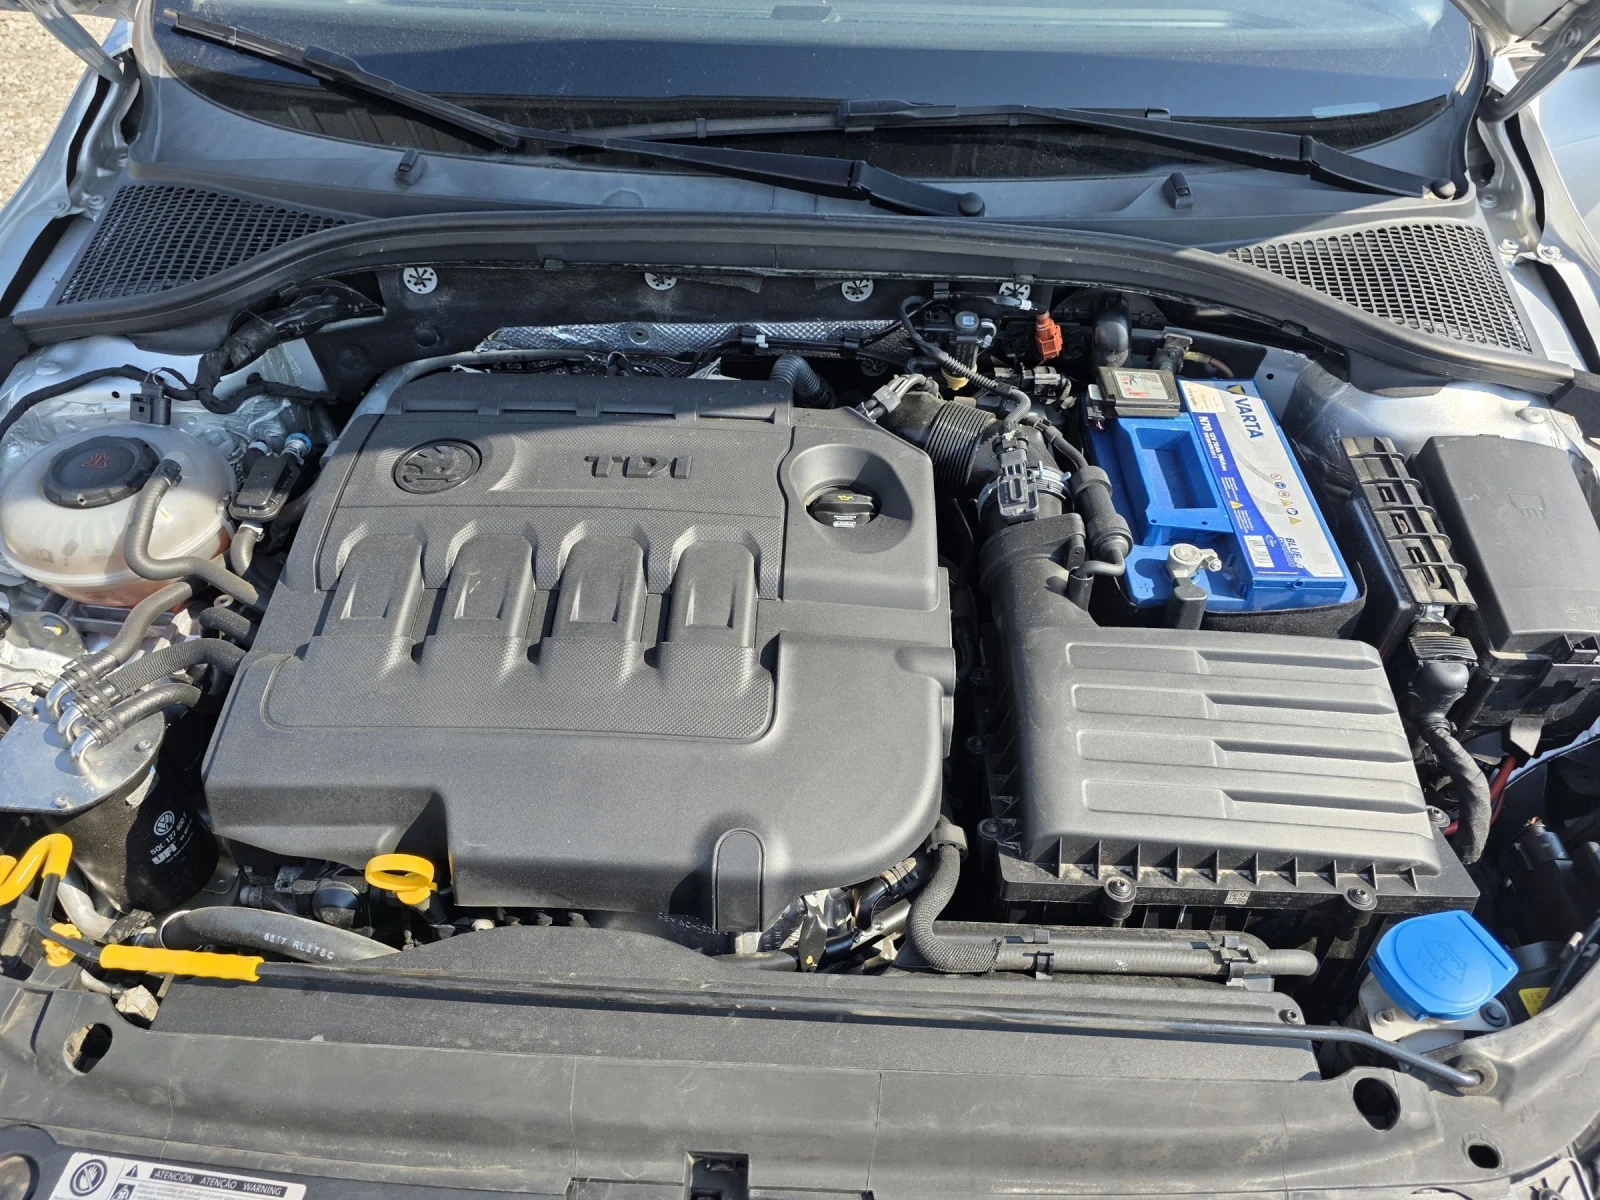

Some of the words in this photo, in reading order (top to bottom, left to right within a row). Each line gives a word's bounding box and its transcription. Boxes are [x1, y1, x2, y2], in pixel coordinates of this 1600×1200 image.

[1198, 416, 1213, 431] N70
[1234, 397, 1264, 439] VARTA
[583, 455, 693, 480] TDI
[1285, 537, 1302, 559] BLUE
[165, 830, 176, 843] 127
[151, 843, 178, 865] UFI
[154, 1169, 194, 1183] ATENCIÓN
[200, 1177, 238, 1190] ATENÇÃO
[243, 1183, 282, 1196] WARNING
